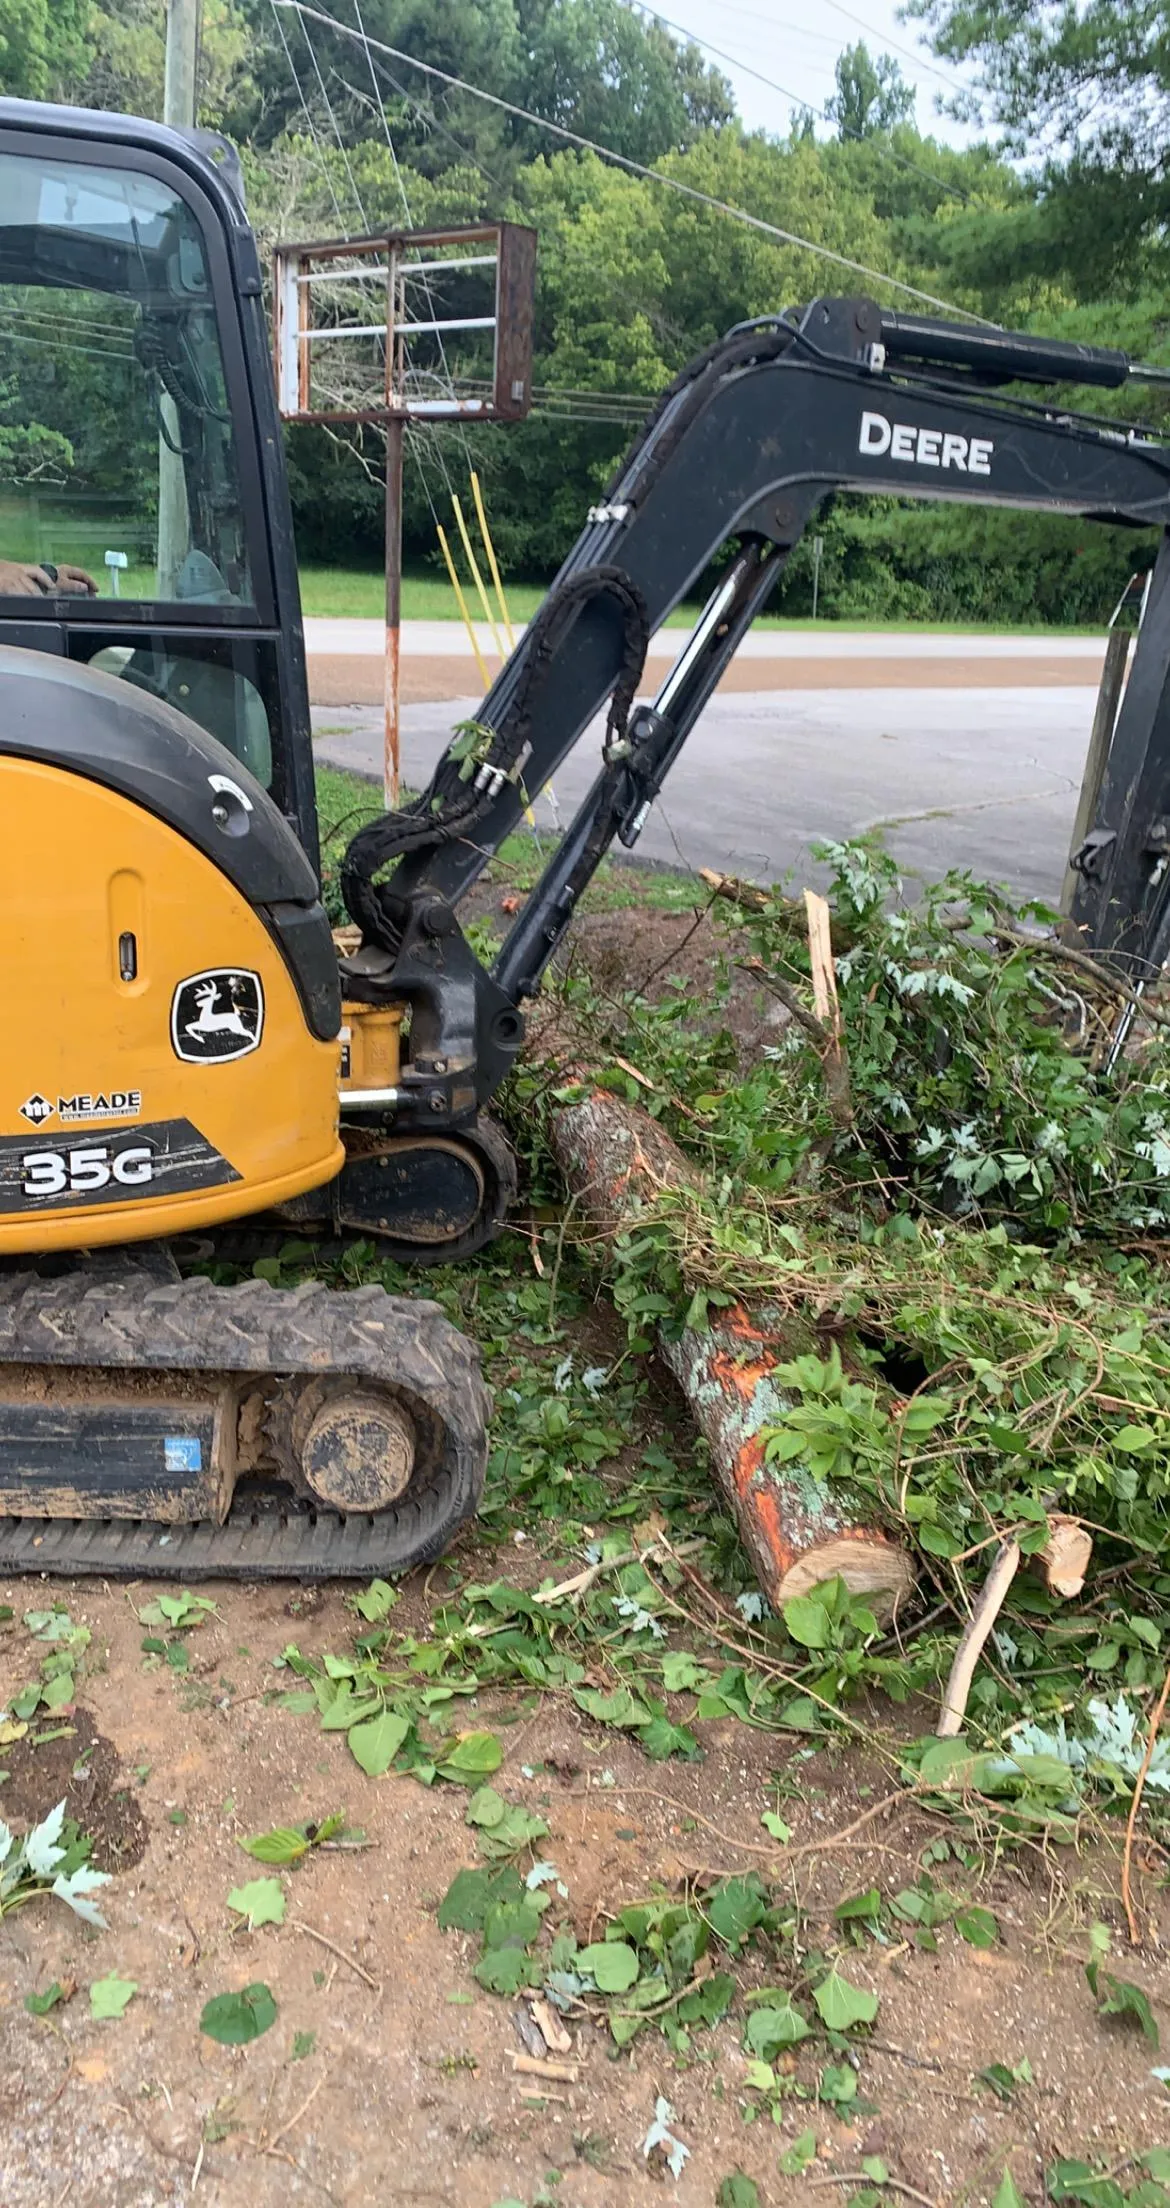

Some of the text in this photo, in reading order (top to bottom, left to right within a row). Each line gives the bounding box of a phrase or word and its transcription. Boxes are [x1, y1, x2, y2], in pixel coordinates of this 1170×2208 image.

[859, 411, 994, 475] DEERE
[58, 1091, 140, 1113] MEADE
[23, 1147, 153, 1195] 35G
